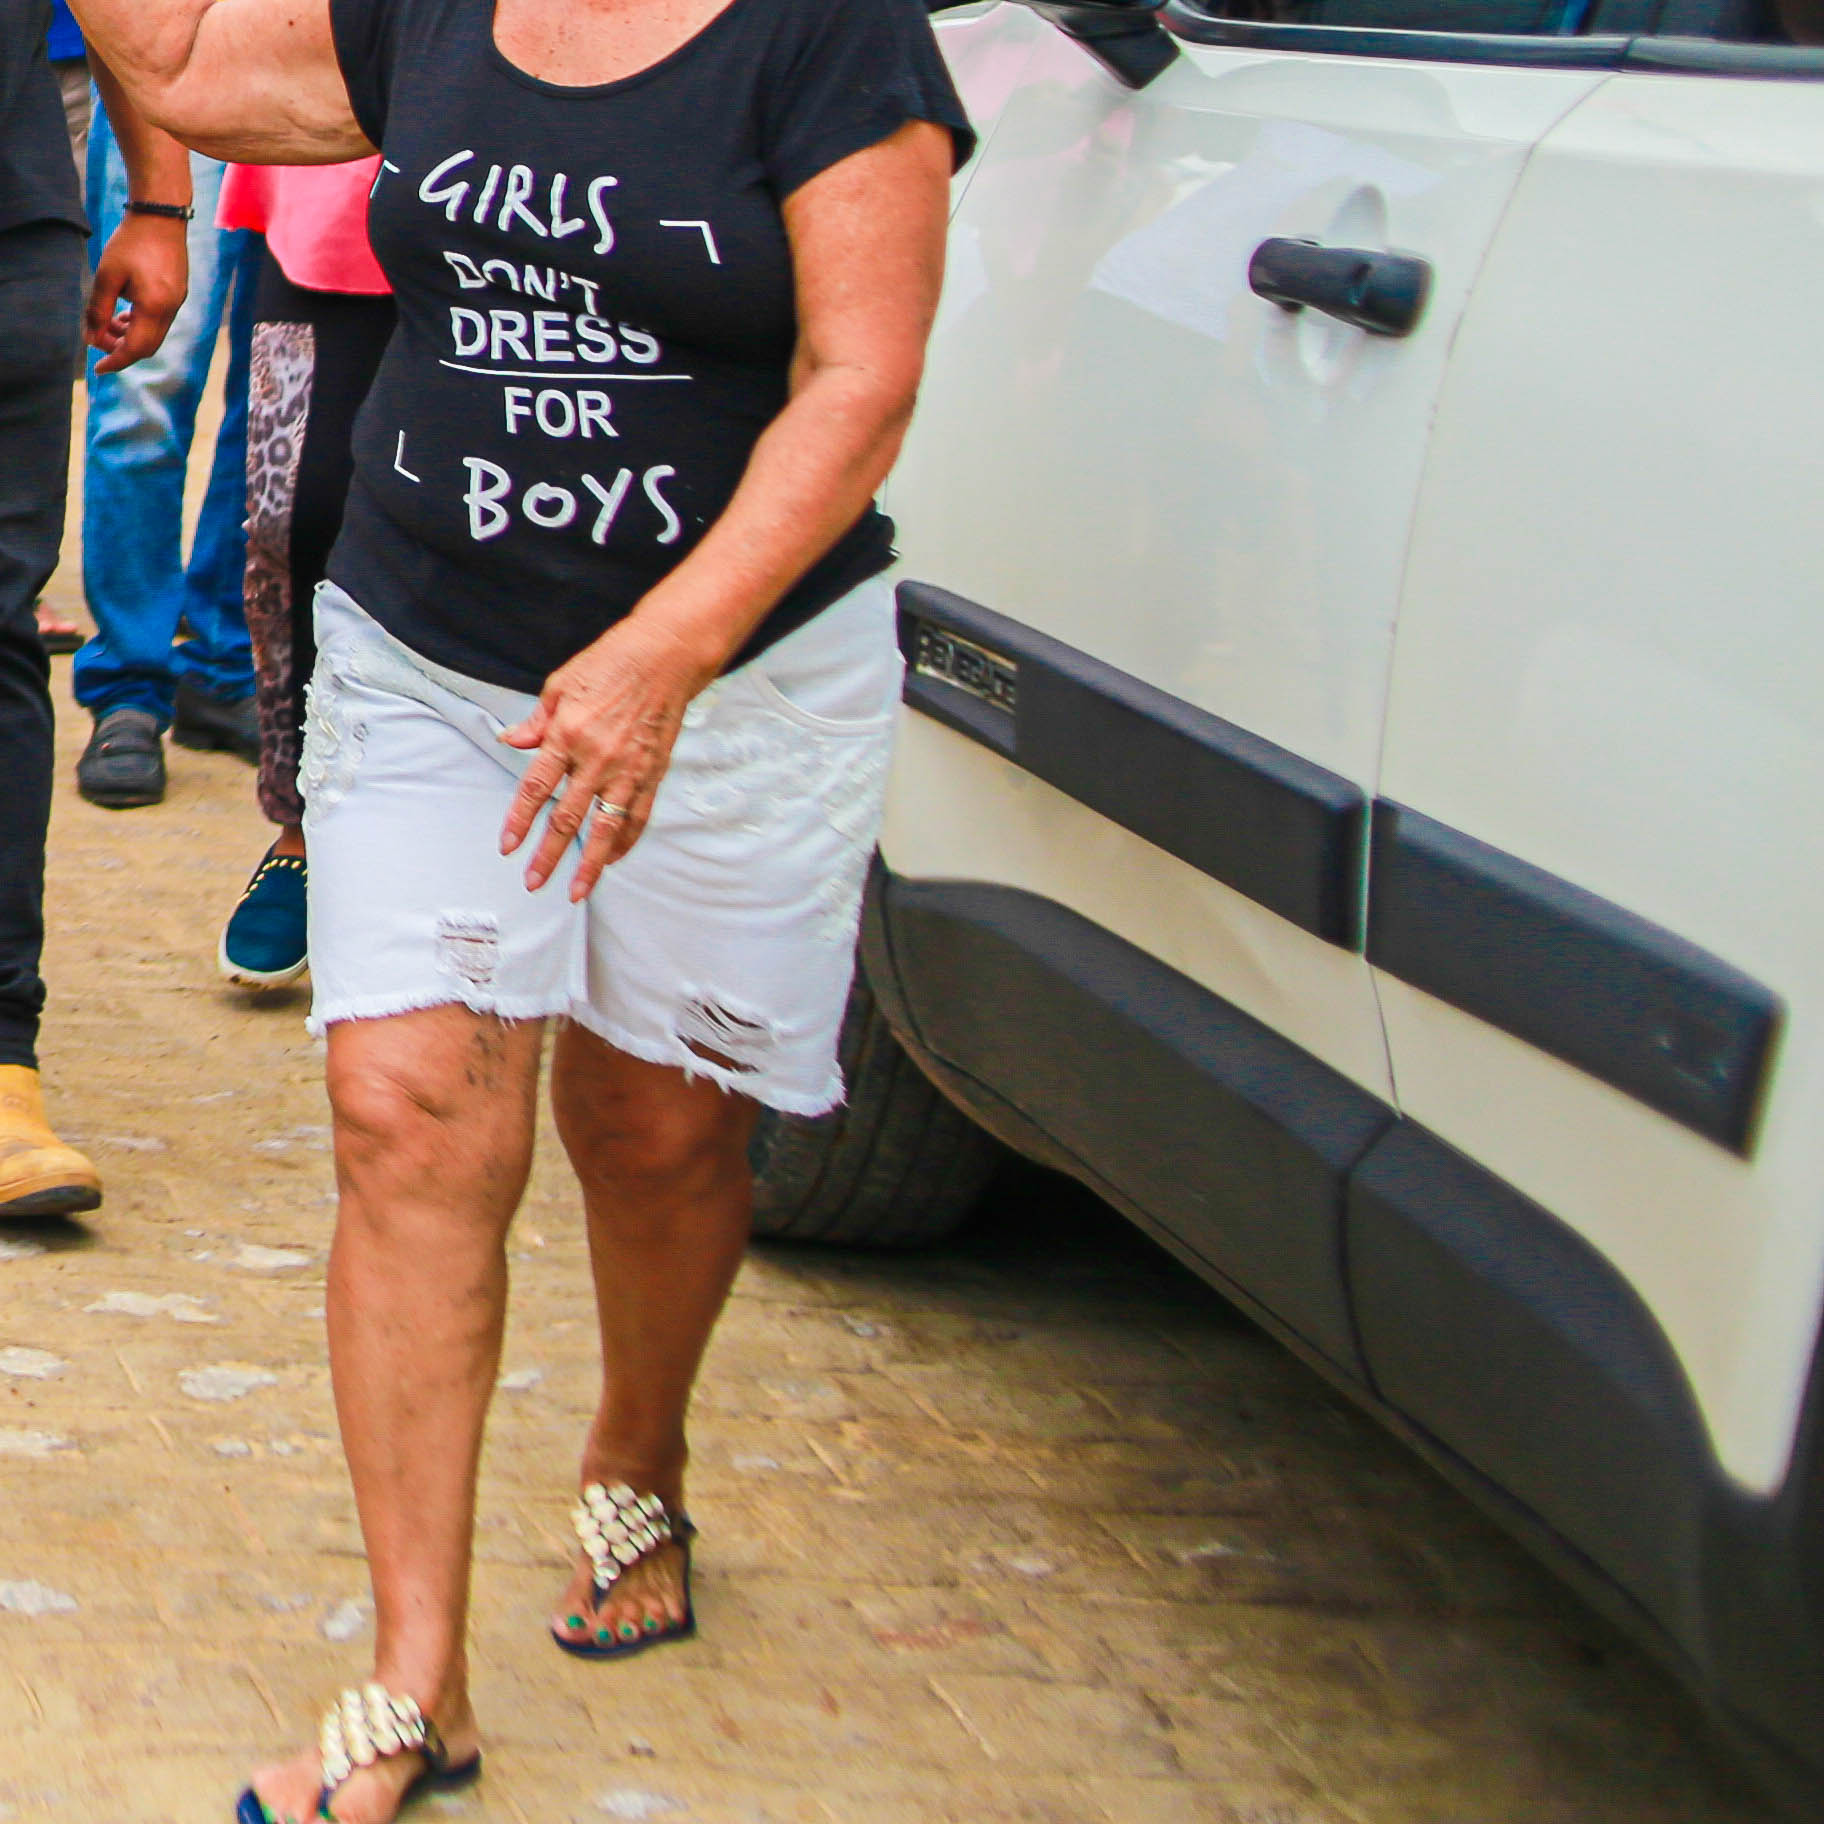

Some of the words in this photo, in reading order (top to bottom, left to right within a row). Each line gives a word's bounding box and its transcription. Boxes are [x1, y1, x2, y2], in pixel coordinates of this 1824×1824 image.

[418, 149, 619, 255] GIRLS
[443, 250, 599, 315] DON'T
[450, 306, 662, 364] DRESS
[504, 386, 619, 439] FOR
[461, 455, 684, 546] BOYS
